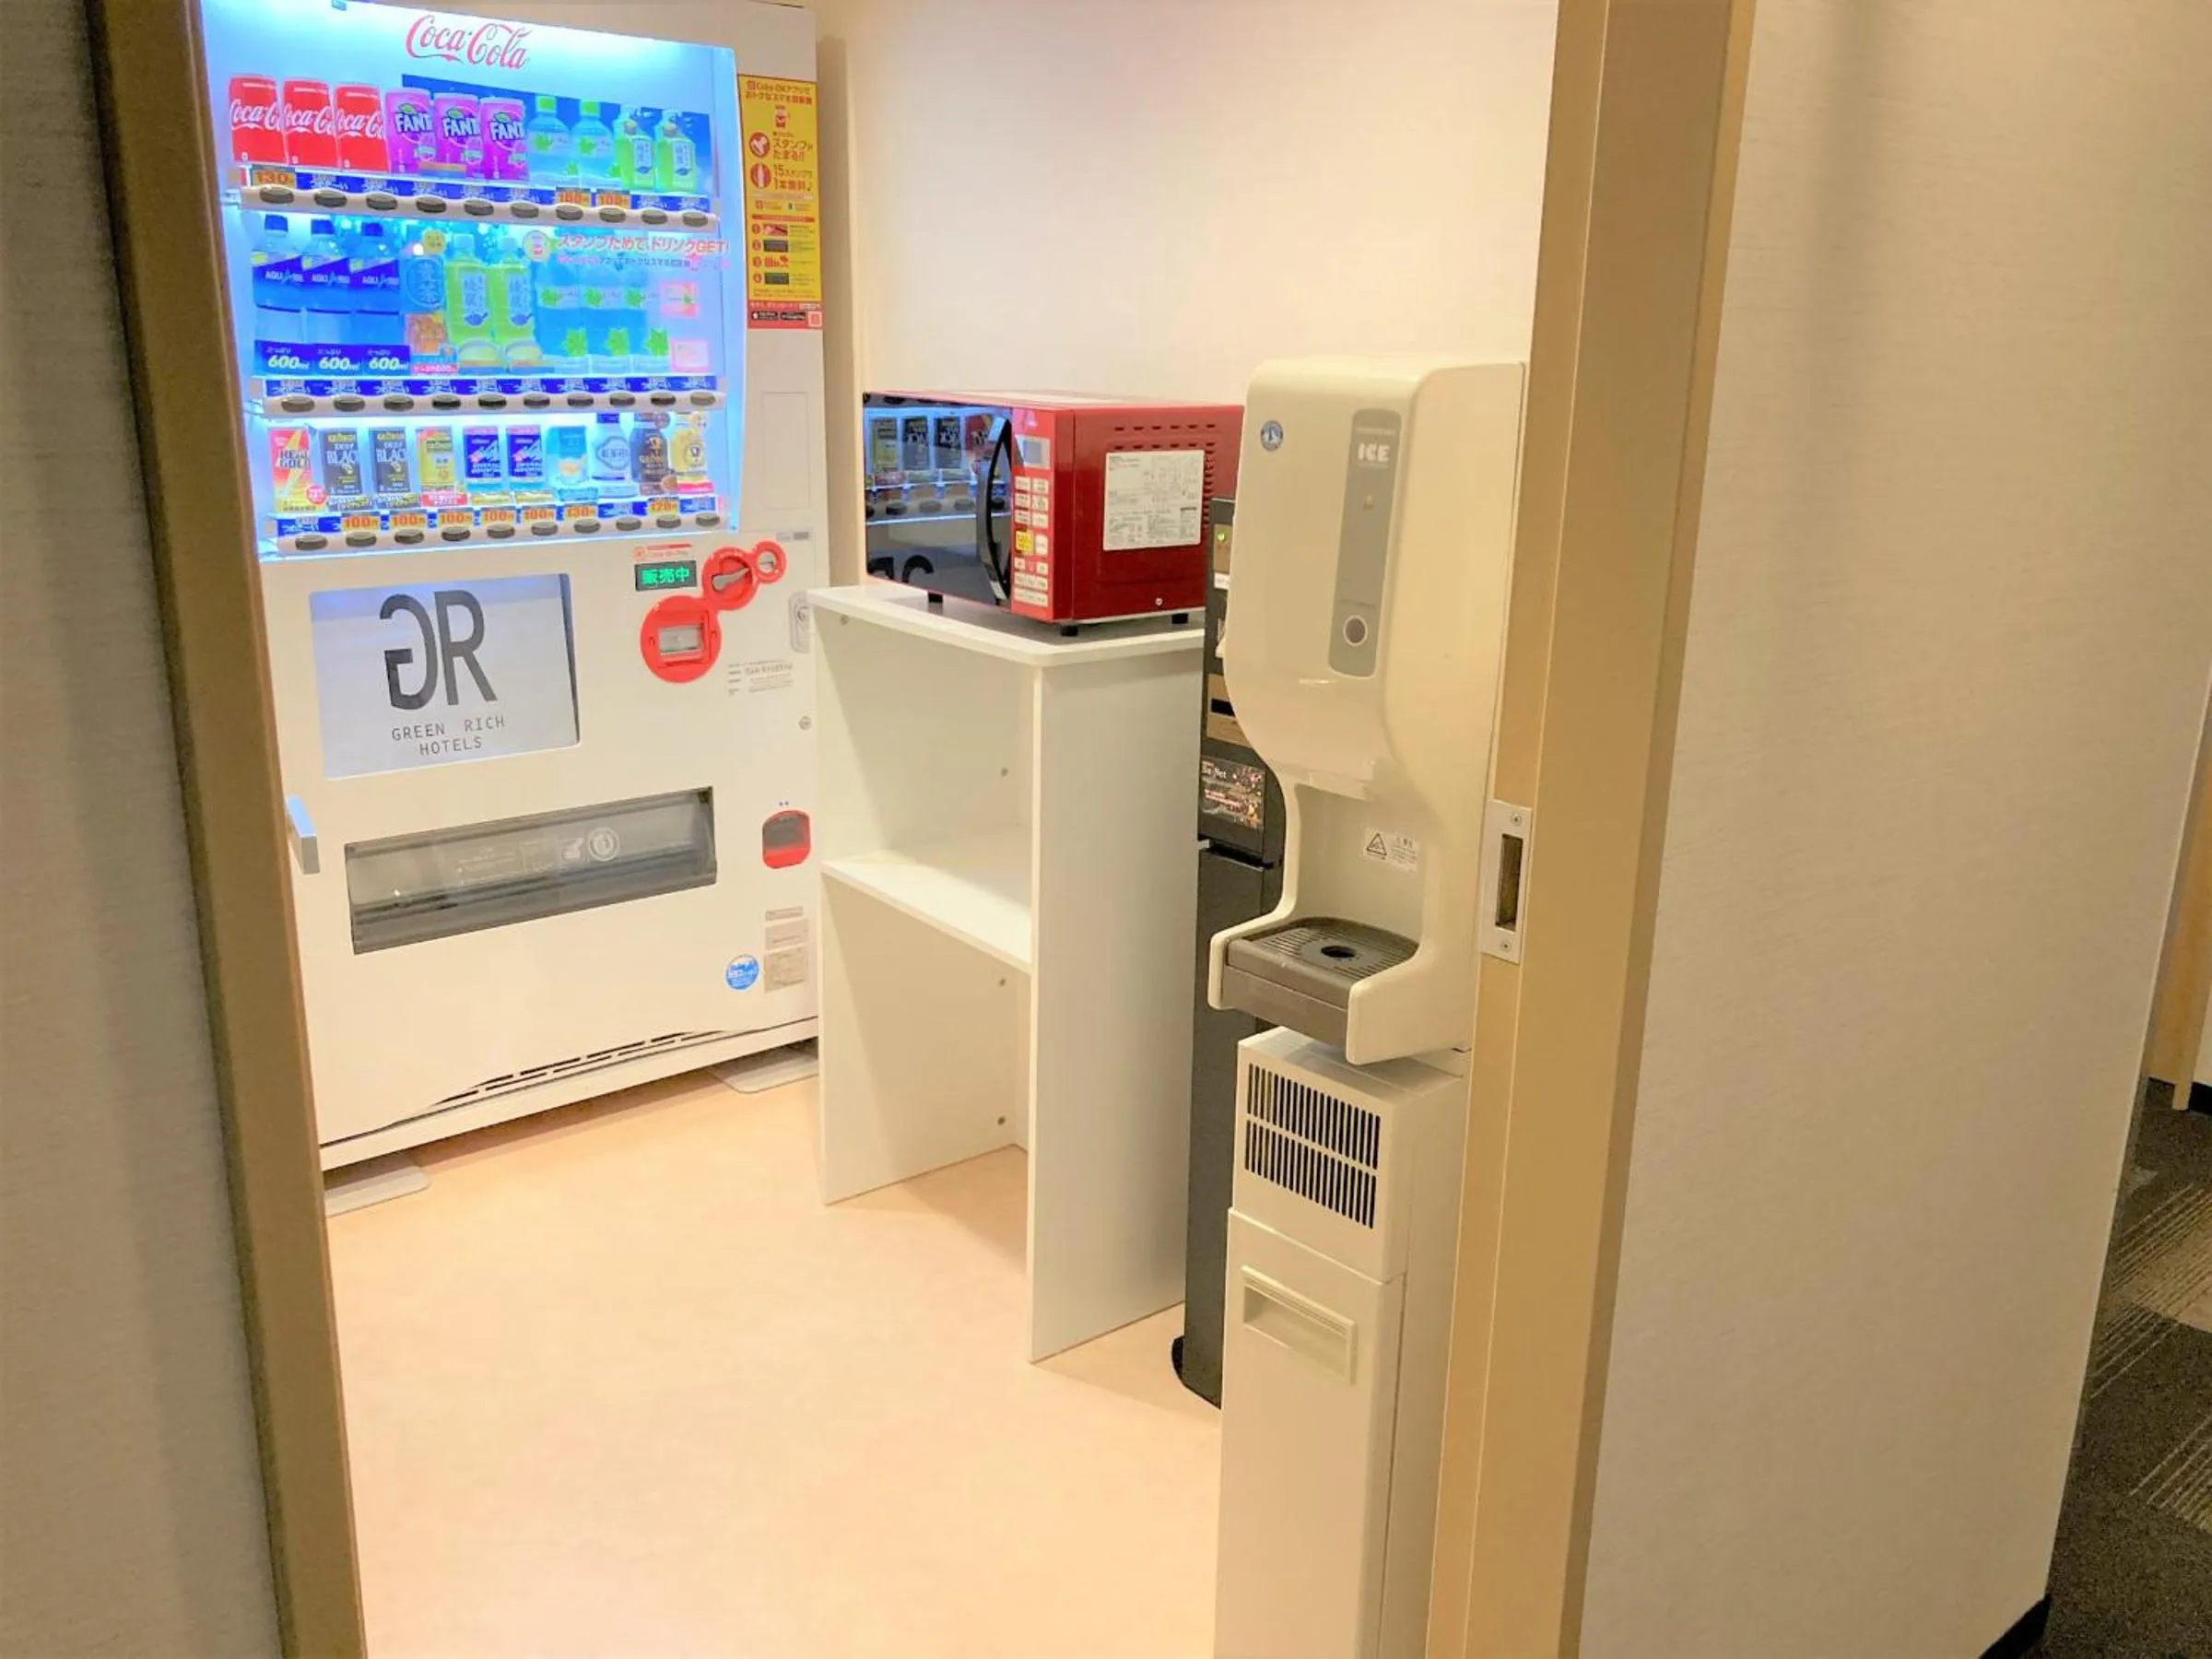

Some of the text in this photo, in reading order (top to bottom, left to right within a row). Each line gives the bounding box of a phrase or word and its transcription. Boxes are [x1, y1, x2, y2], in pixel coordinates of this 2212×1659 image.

[406, 15, 532, 69] Coca-Cola
[230, 99, 280, 132] Coca-Co
[394, 112, 433, 133] FANT
[441, 117, 480, 137] FANT
[489, 122, 524, 141] FANT
[326, 450, 357, 465] BLAC
[376, 448, 406, 462] BLAC
[1358, 442, 1391, 462] ICE
[392, 715, 505, 742] GREEN RICH
[419, 736, 483, 755] HOTELS
